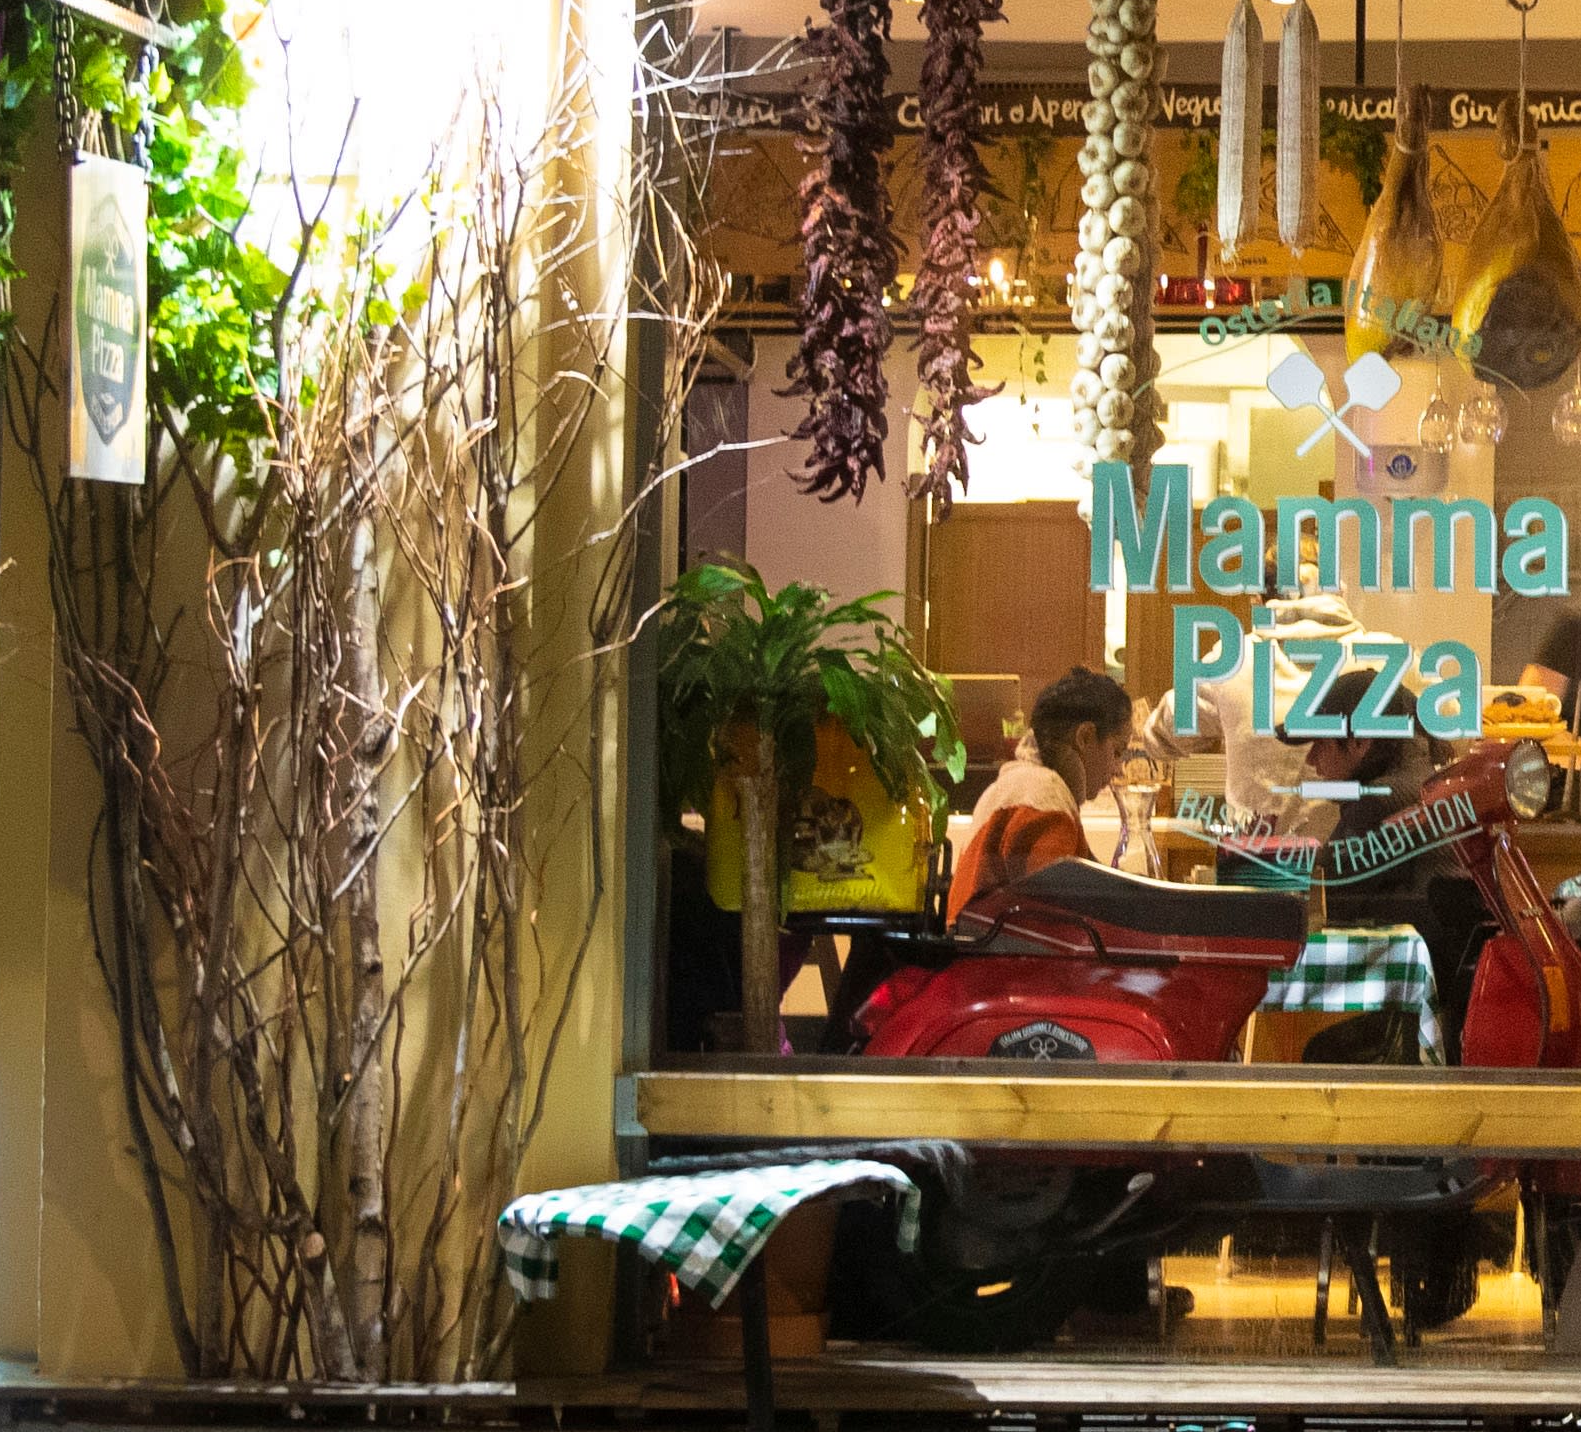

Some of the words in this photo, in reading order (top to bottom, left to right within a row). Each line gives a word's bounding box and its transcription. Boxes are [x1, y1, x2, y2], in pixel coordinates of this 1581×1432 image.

[84, 263, 135, 336] Mamma
[1199, 281, 1333, 346] Osteria
[1348, 279, 1483, 359] Italiana
[91, 323, 125, 385] Pizza
[1090, 460, 1571, 597] Mamma
[1171, 604, 1484, 740] Pizza
[1276, 833, 1320, 873] ON
[1332, 790, 1478, 875] TRADITION
